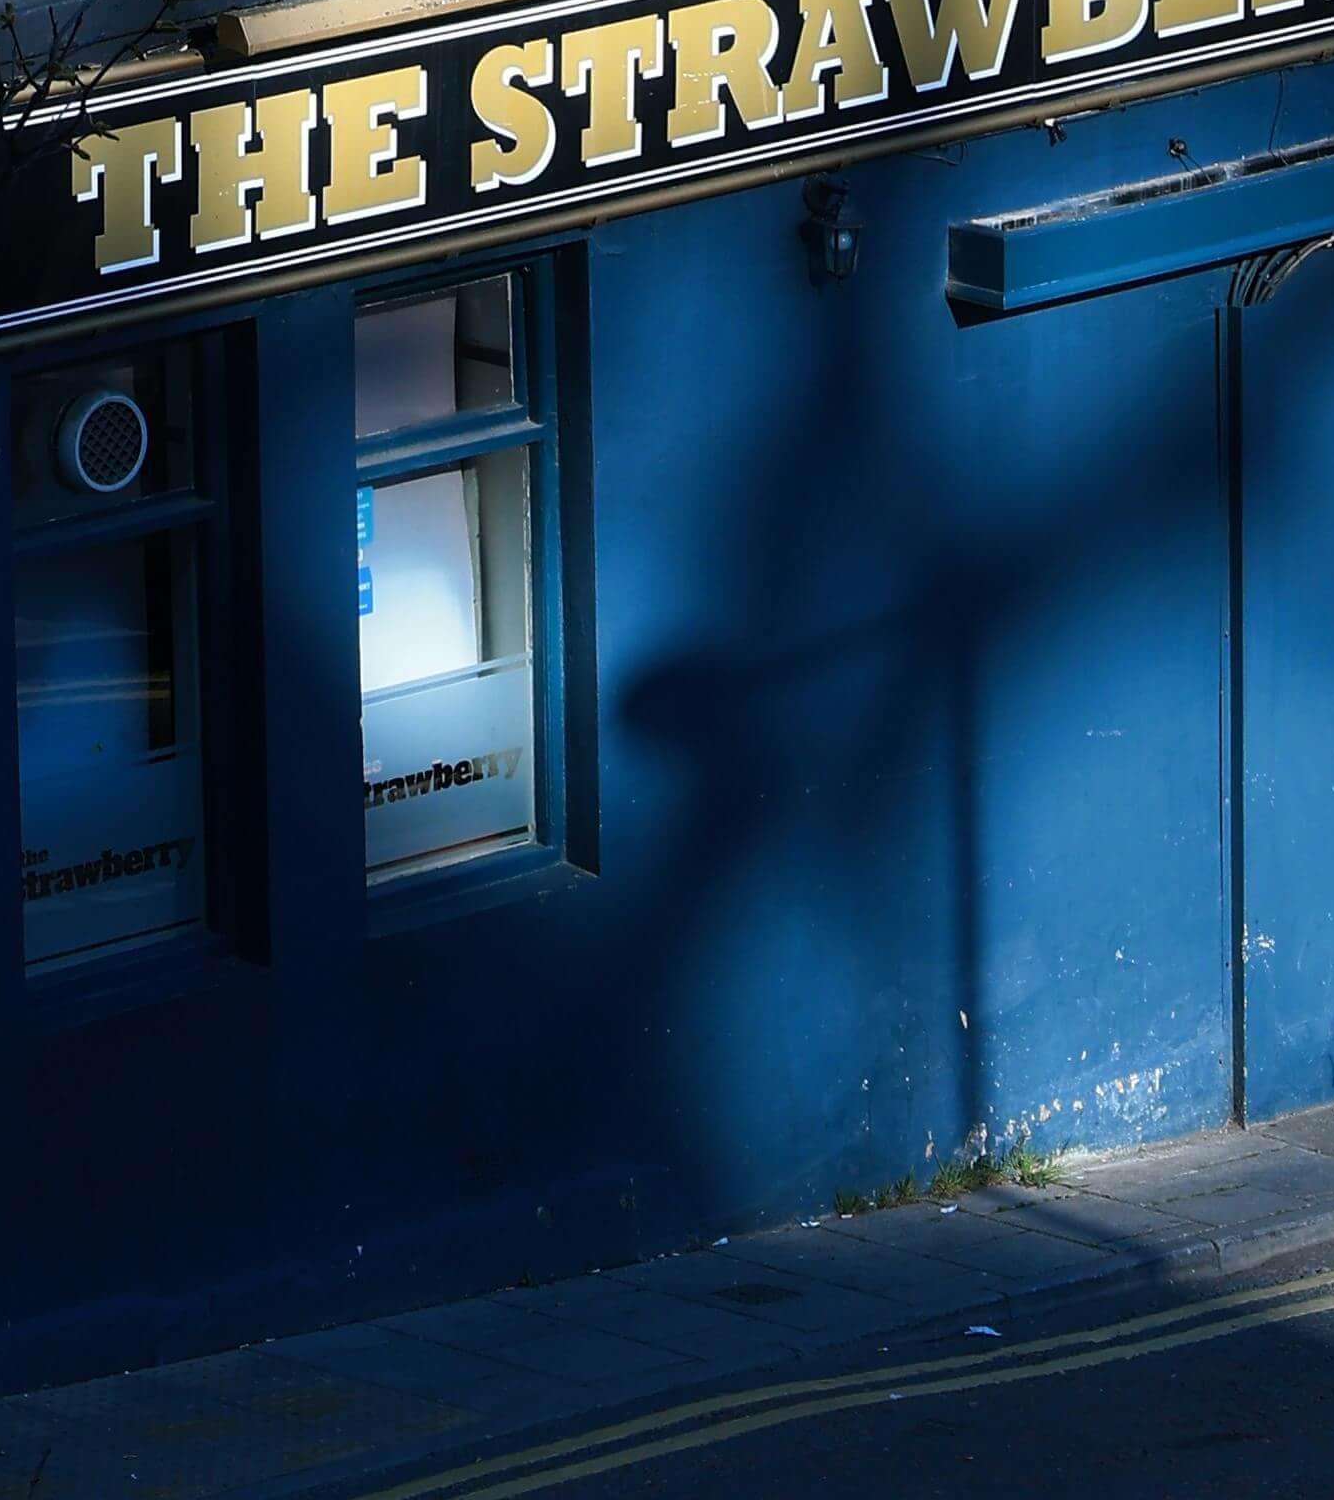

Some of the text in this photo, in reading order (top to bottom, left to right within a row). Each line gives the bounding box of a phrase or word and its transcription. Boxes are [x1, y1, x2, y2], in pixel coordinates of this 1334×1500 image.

[73, 62, 428, 275] THE
[363, 747, 523, 810] trawberry
[20, 835, 196, 900] trawberry
